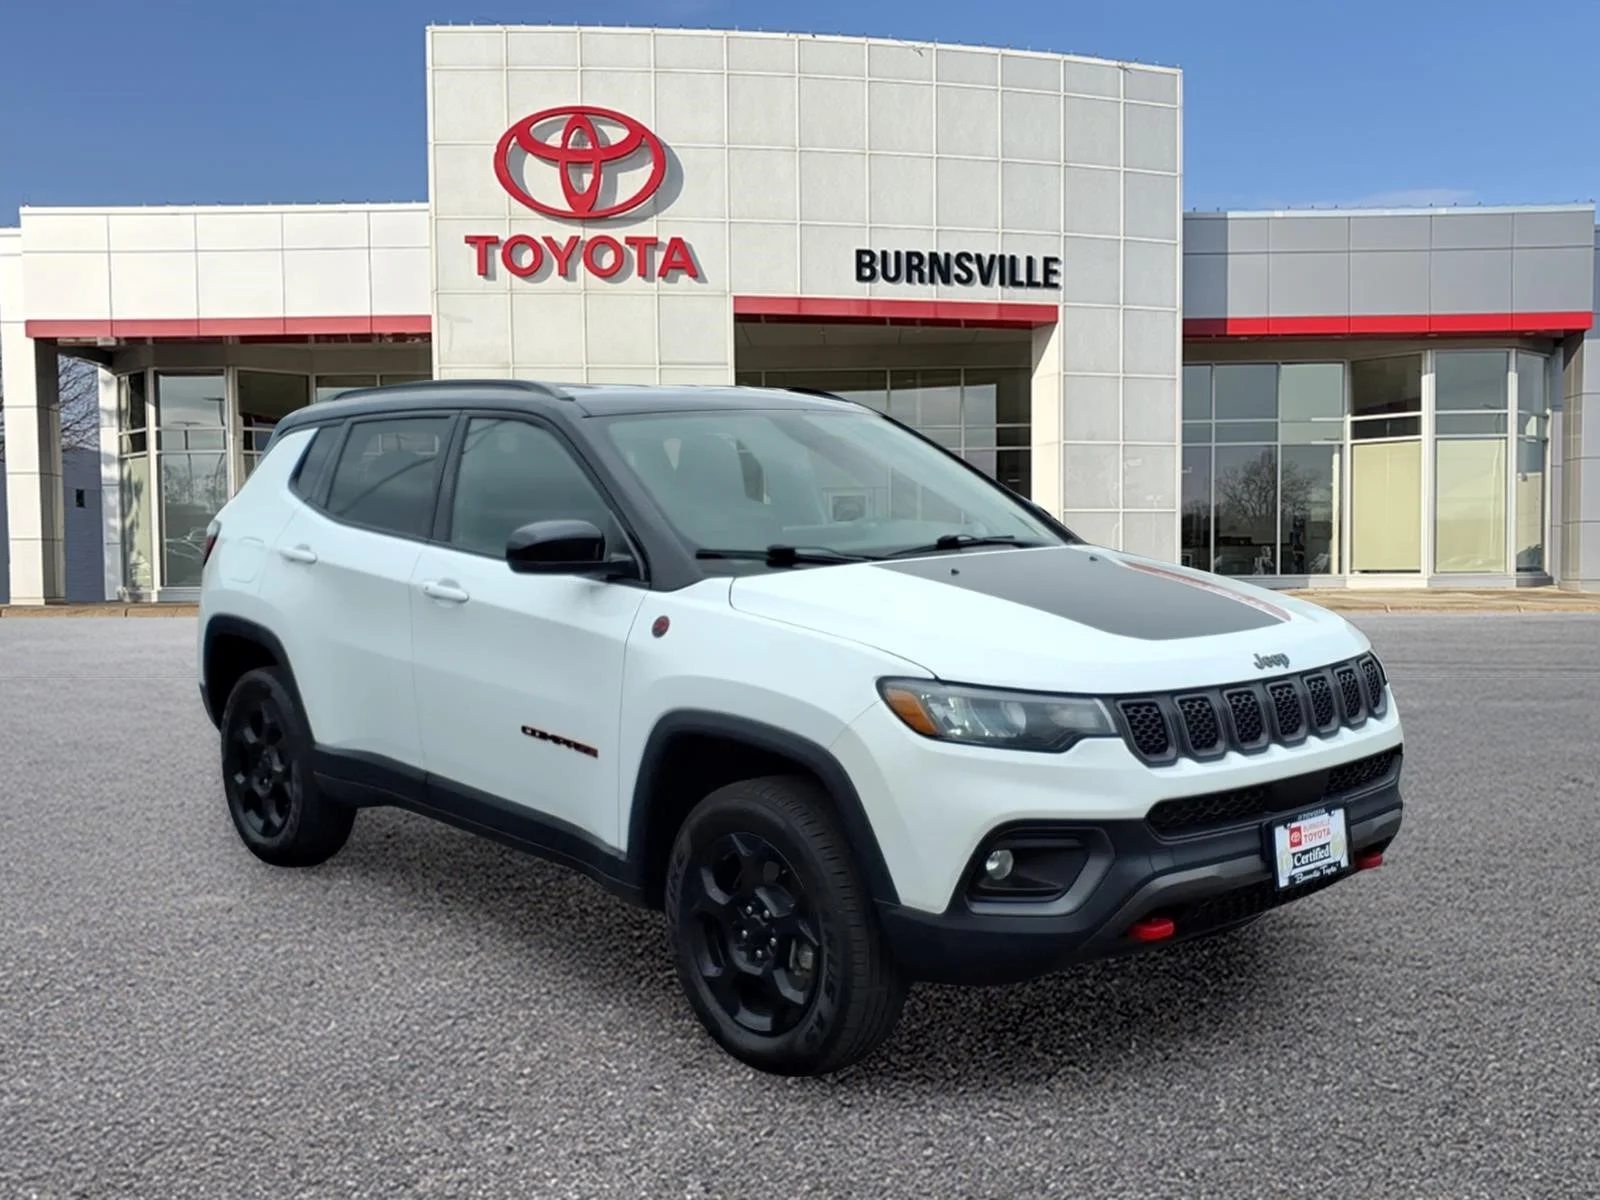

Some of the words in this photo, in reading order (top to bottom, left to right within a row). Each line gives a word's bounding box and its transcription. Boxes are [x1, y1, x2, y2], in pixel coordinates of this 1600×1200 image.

[464, 234, 699, 279] TOYOTA
[855, 248, 1062, 290] BURNSVILLE
[1253, 652, 1290, 671] Jeep
[1303, 827, 1331, 843] TOYOTA
[1294, 846, 1330, 867] Certified
